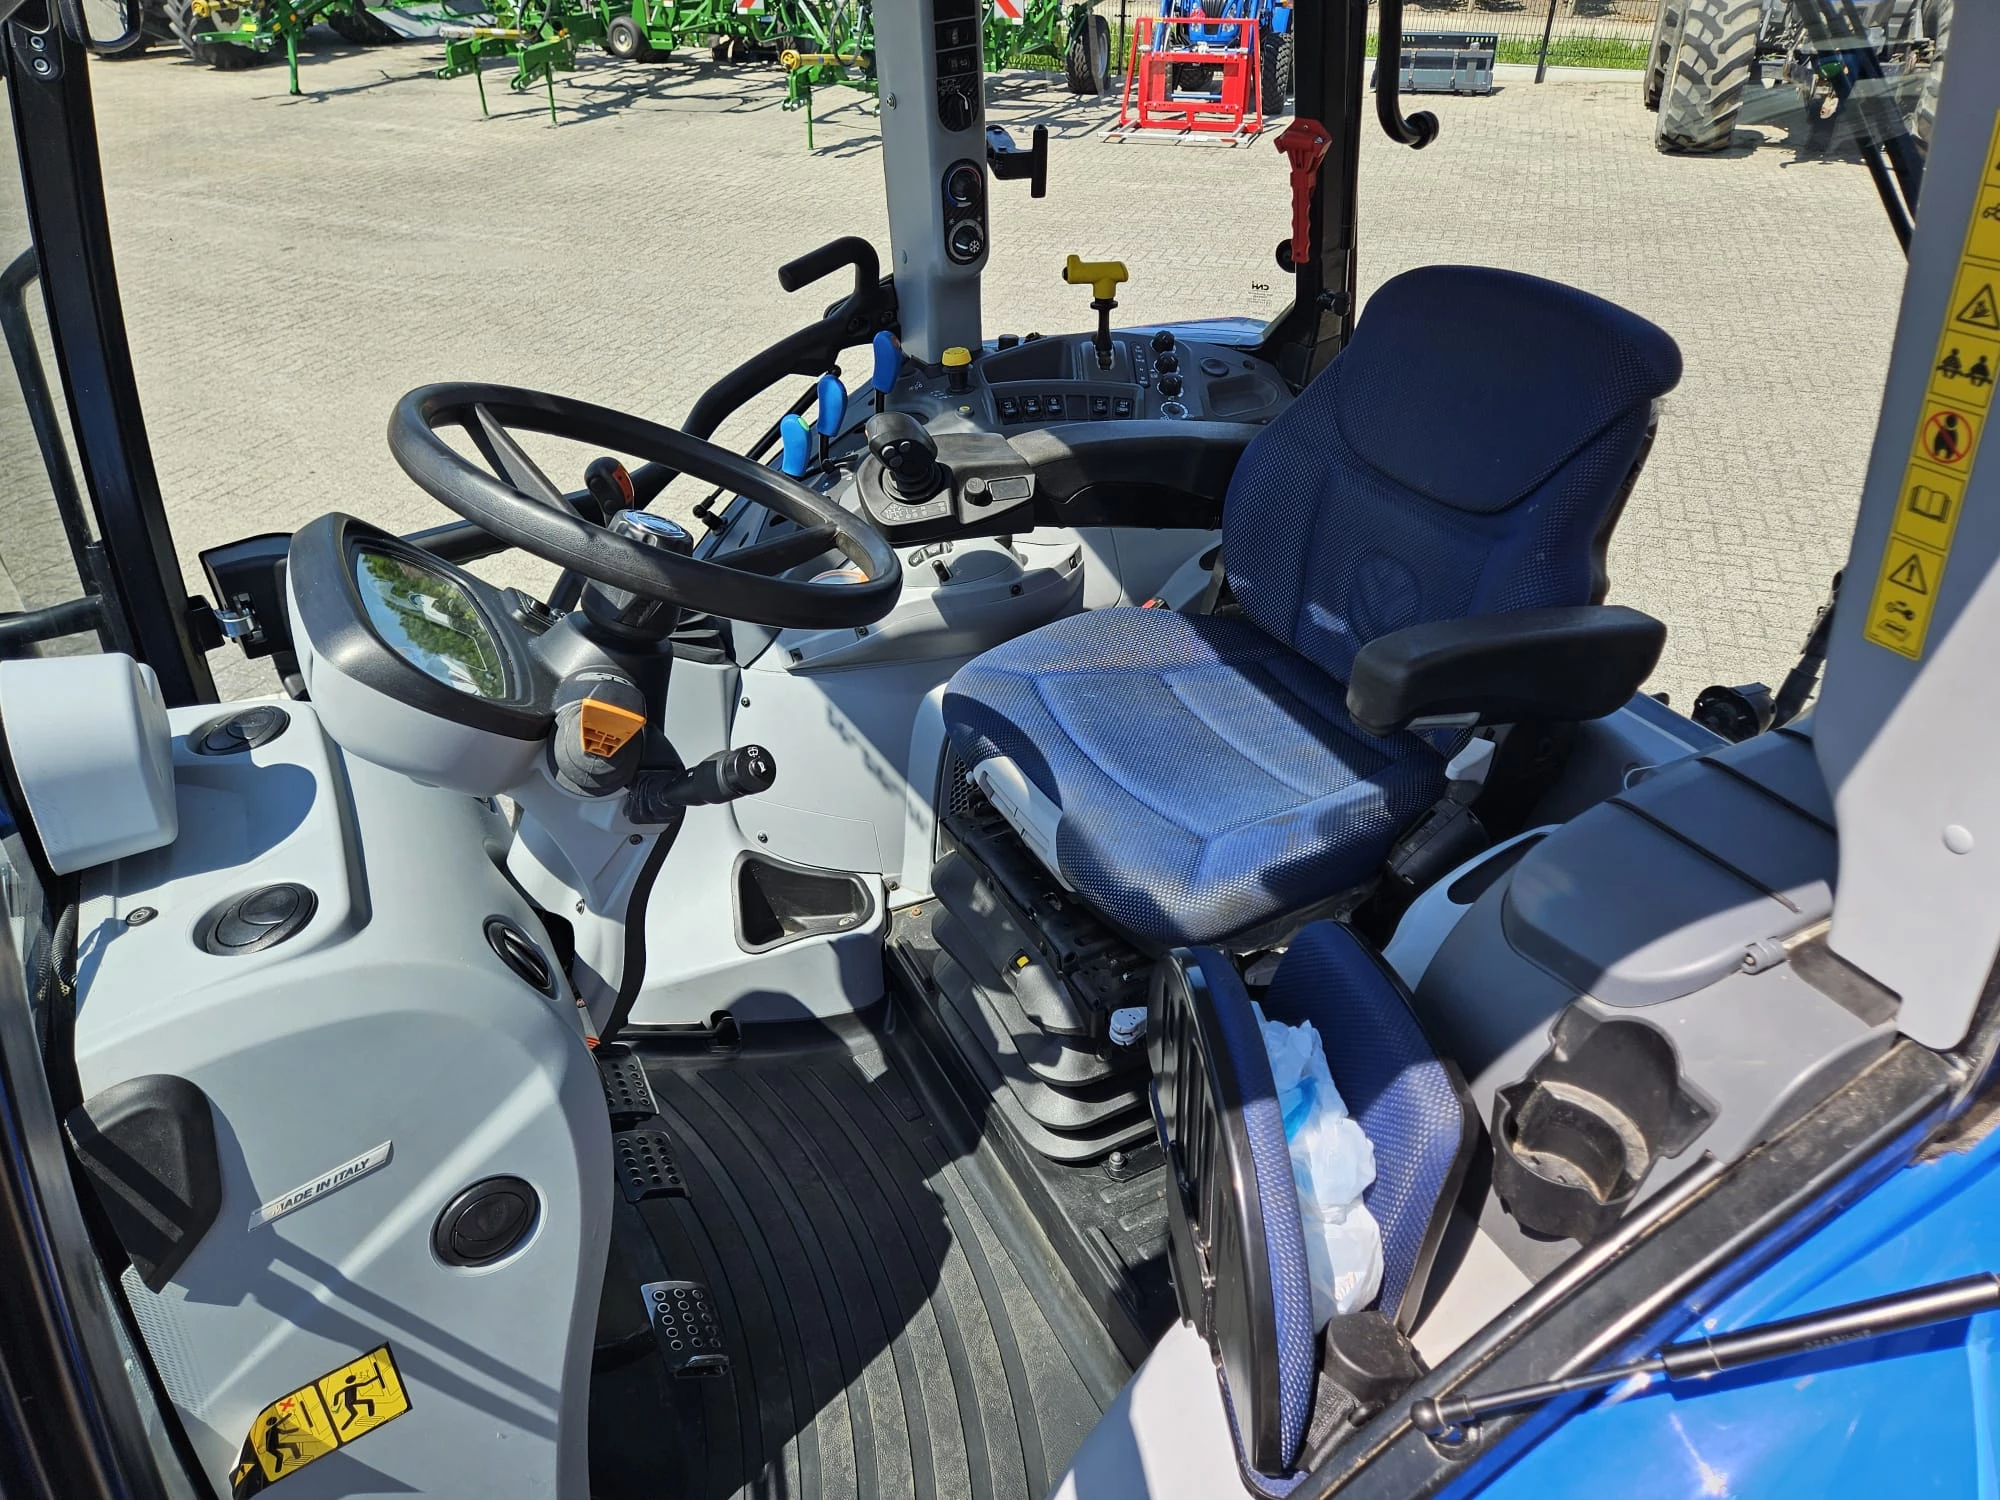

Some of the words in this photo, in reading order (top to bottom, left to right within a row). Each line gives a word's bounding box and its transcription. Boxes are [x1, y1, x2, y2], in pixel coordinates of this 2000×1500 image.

[272, 1188, 313, 1216] MADE
[316, 1179, 331, 1193] IN
[333, 1158, 369, 1183] ITALY
